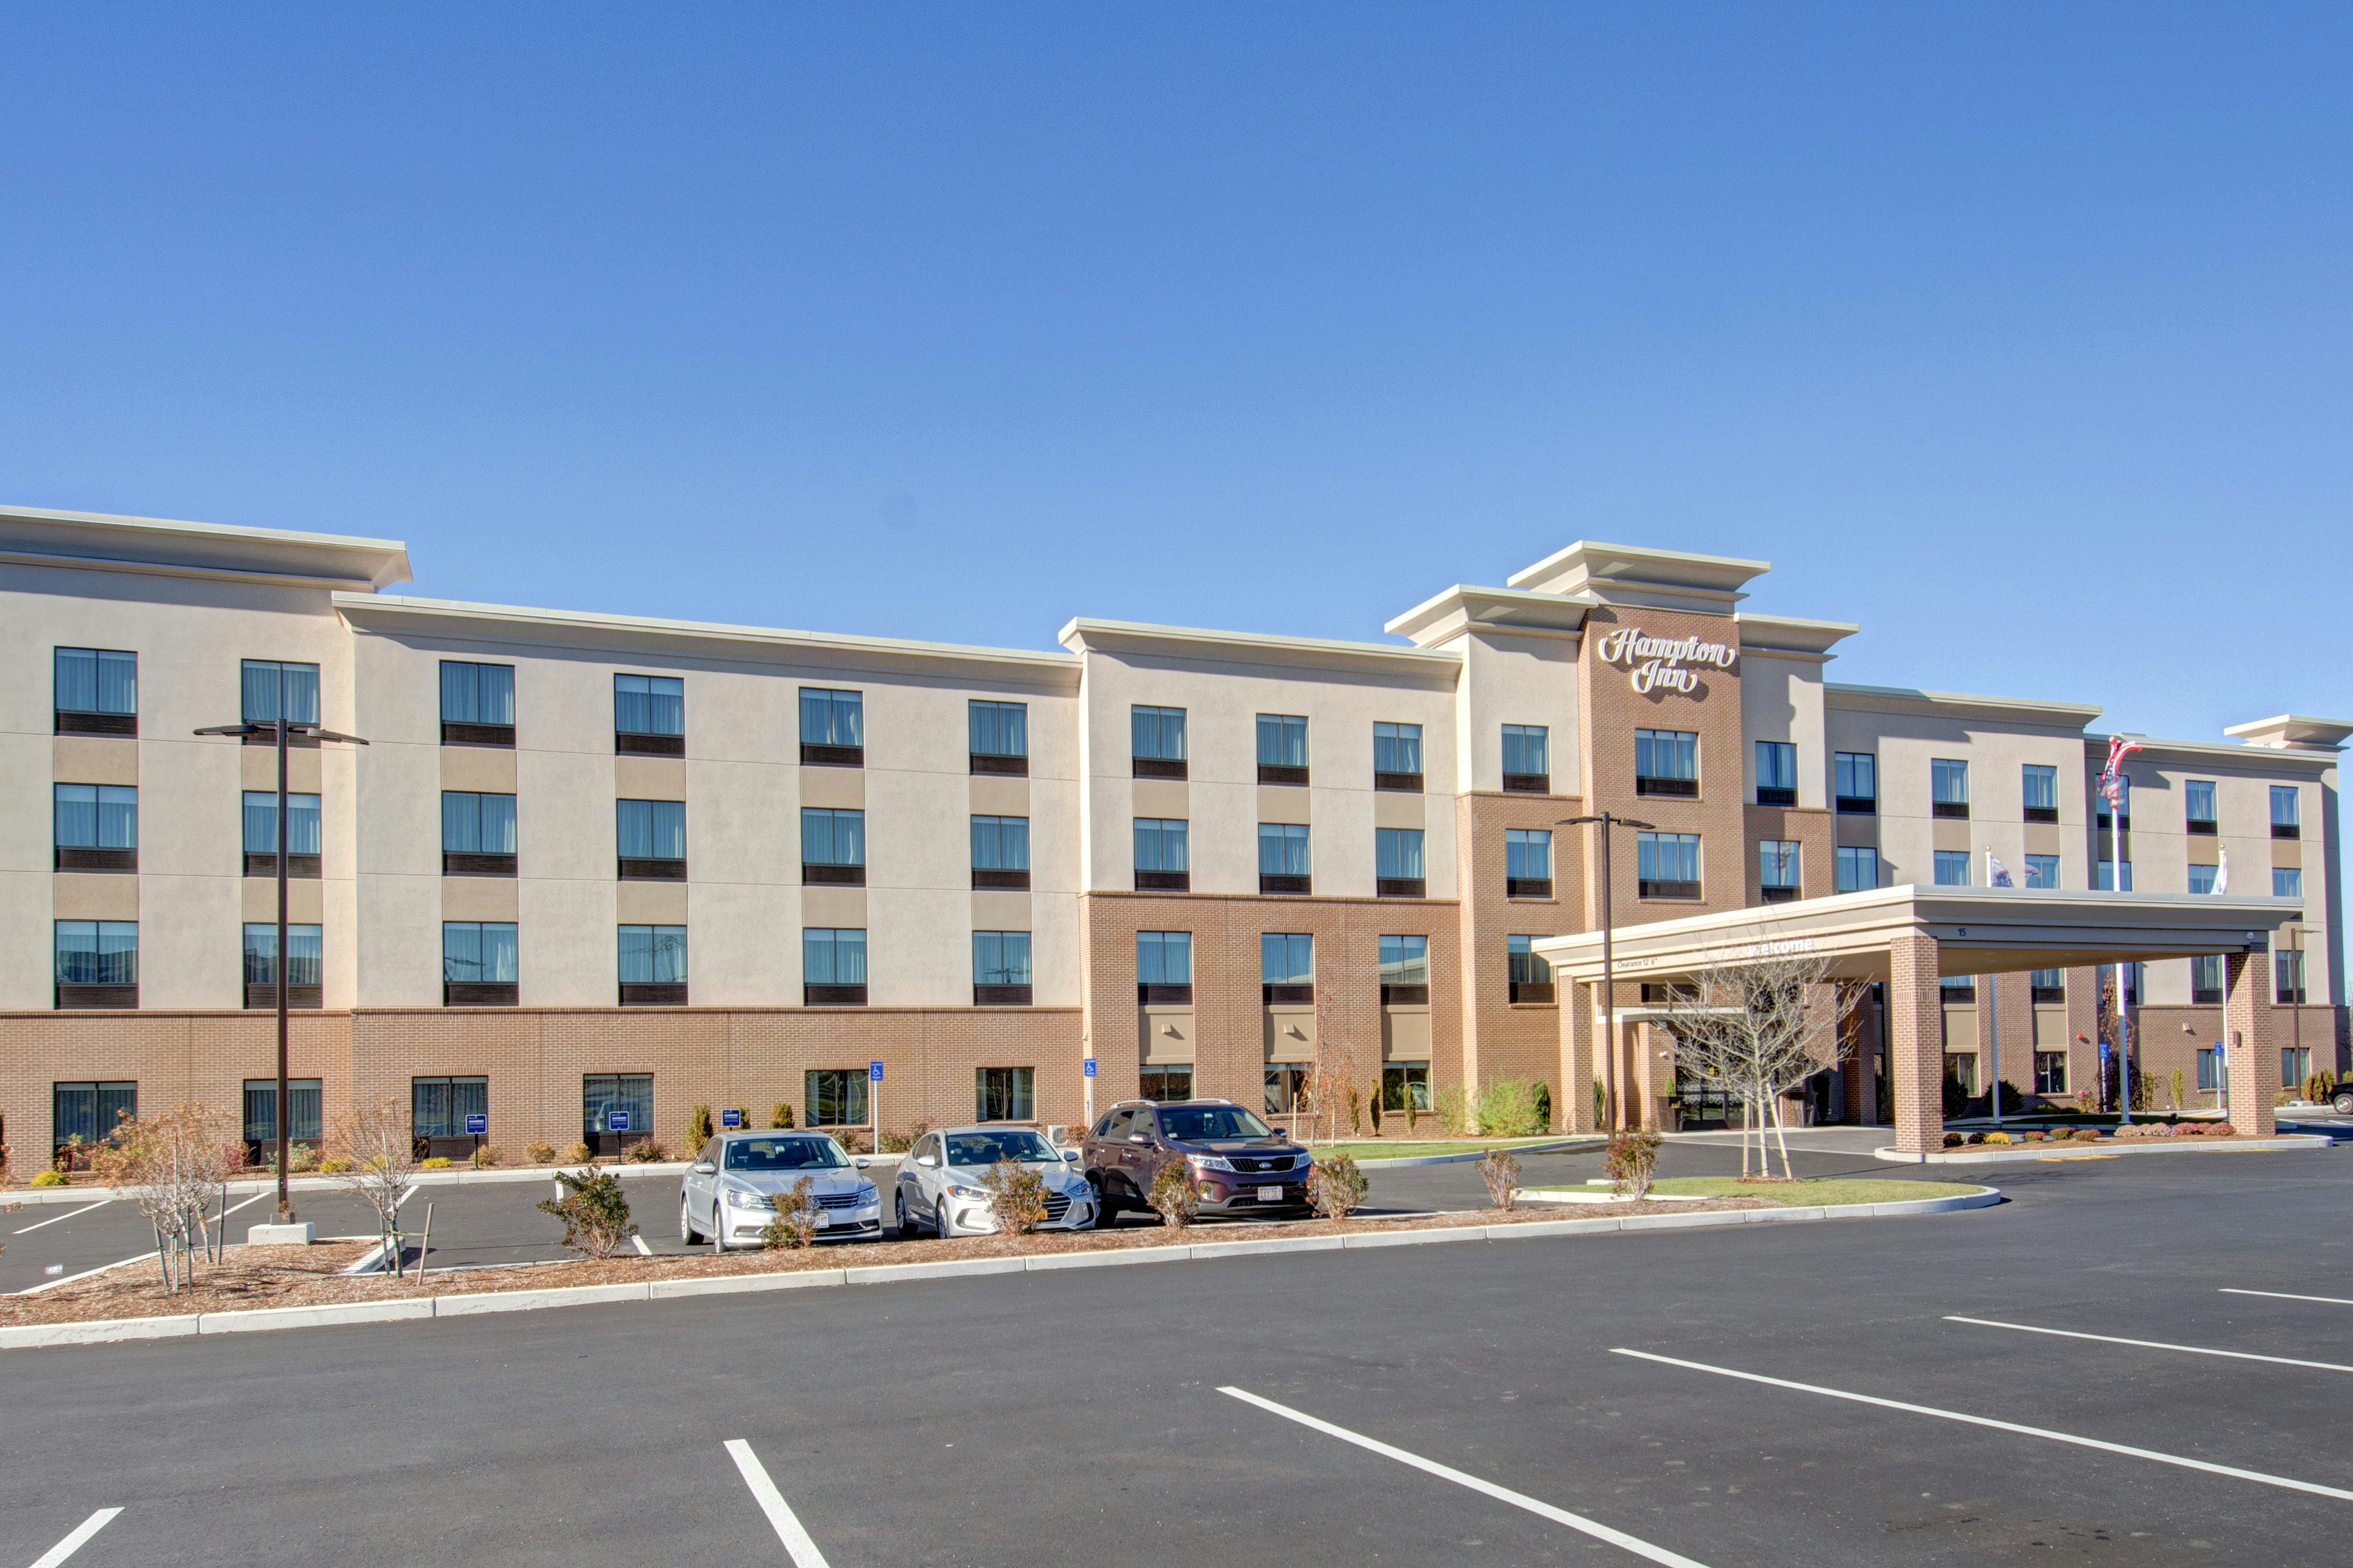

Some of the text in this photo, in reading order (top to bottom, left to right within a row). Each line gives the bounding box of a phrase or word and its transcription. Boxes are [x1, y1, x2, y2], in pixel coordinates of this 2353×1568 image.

[1598, 627, 1736, 667] Hampton
[1632, 659, 1698, 694] Inn
[1958, 928, 1966, 936] 15
[1748, 938, 1813, 956] welcome
